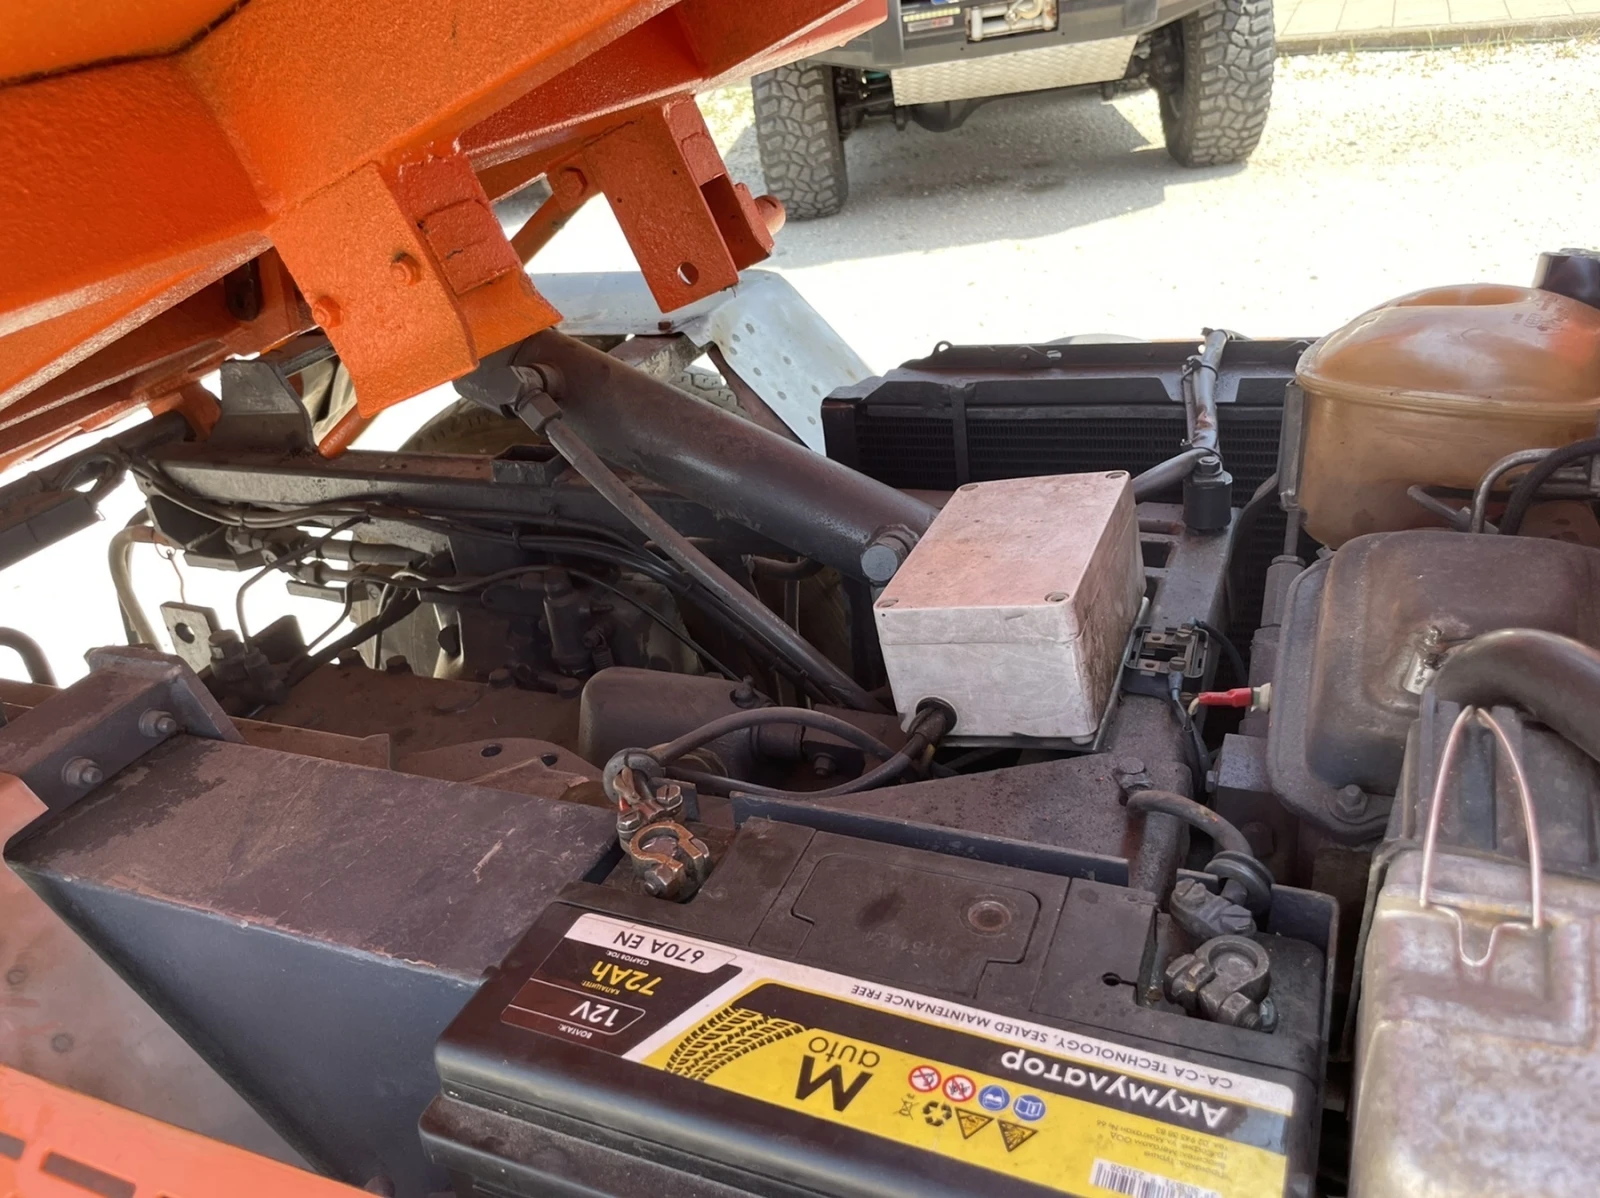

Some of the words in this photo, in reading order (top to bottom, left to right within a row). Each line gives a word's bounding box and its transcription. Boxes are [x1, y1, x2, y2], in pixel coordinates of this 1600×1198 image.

[613, 930, 645, 948] EN
[651, 939, 705, 964] 670A
[591, 960, 663, 996] 72Ah
[850, 984, 882, 1000] FREE
[570, 1000, 620, 1027] 12V
[885, 992, 990, 1027] MAINTENANCE
[558, 1023, 593, 1039] ВОЛТАЖ:
[994, 1021, 1048, 1043] SEALED
[808, 1036, 880, 1071] auto
[1054, 1033, 1167, 1073] TECHNOLOGY,
[795, 1054, 872, 1112] M
[1001, 1049, 1227, 1128] Акумулатор
[1173, 1066, 1233, 1090] CA-CA
